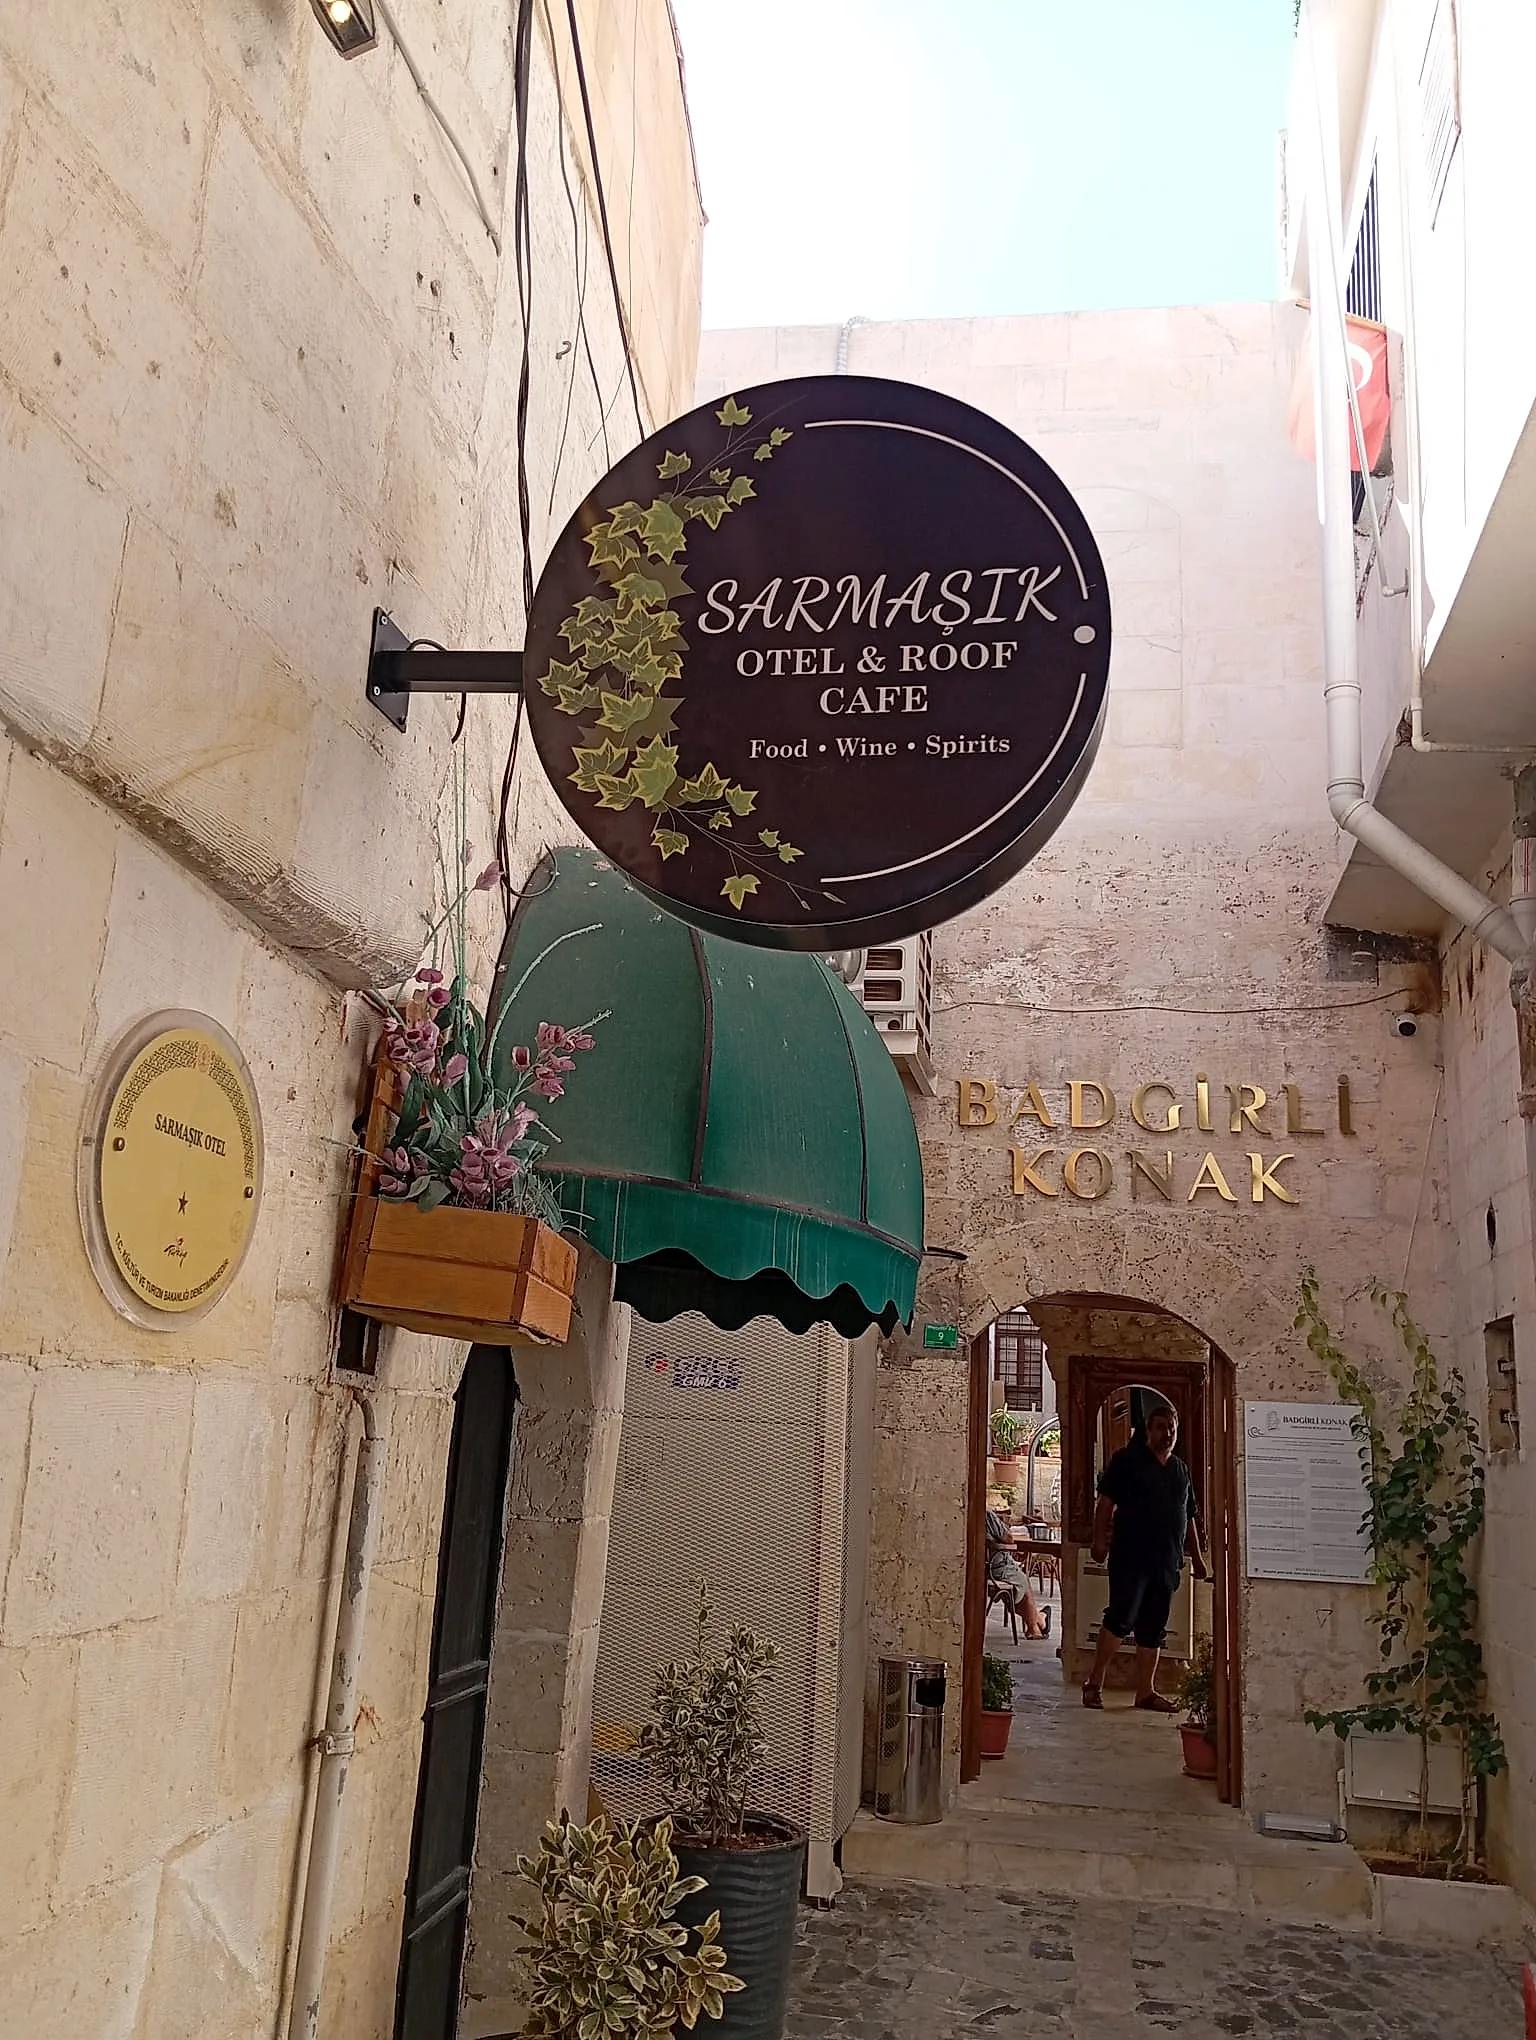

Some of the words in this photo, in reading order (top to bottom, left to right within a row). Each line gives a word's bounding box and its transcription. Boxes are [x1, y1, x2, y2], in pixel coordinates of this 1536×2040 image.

[697, 564, 1062, 637] SARMAŞIK
[736, 647, 845, 676] OTEL
[857, 645, 886, 673] &
[899, 641, 1018, 672] ROOF
[819, 685, 929, 716] CAFE
[749, 738, 808, 760] Food
[835, 736, 897, 757] Wine
[925, 734, 1010, 758] Spirits
[954, 1072, 1357, 1135] BADGİRLİ
[155, 1113, 204, 1148] SARMAŞIK
[204, 1134, 226, 1157] OTEL
[1008, 1147, 1300, 1204] KONAK
[938, 1331, 945, 1341] 9
